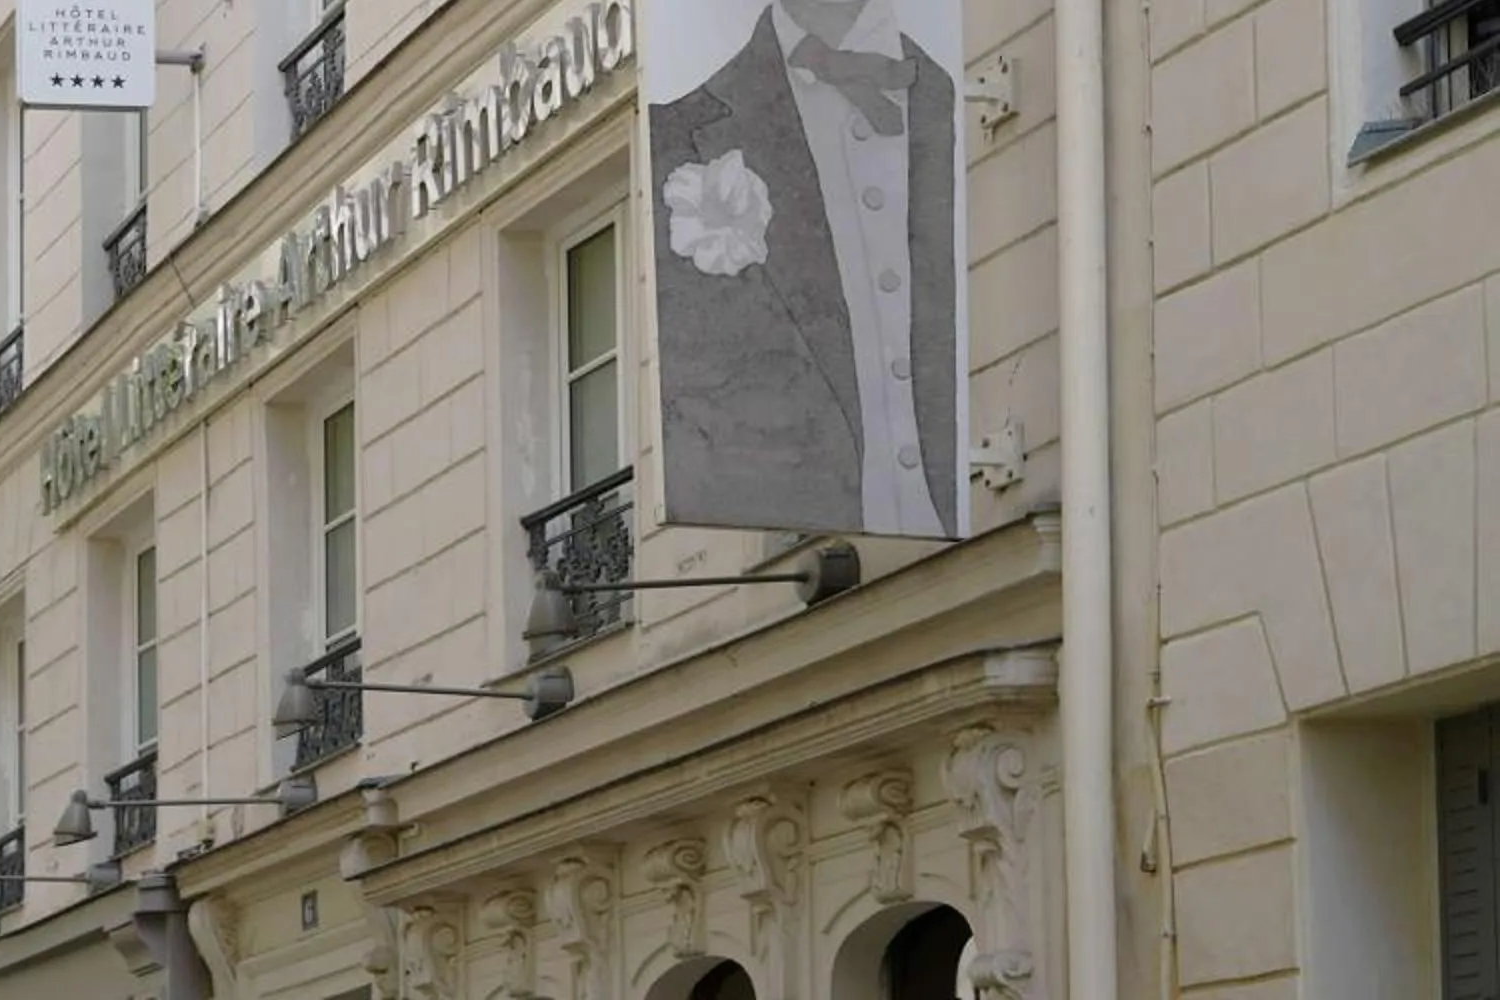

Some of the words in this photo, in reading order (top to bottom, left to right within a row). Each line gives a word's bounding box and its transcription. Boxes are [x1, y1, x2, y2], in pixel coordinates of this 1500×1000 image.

[55, 5, 117, 21] HÔTEL
[28, 20, 146, 36] LITTÉRAIRE
[49, 36, 126, 48] ARTHUR
[43, 49, 132, 62] RIMBAUD
[272, 161, 404, 328] Arthur
